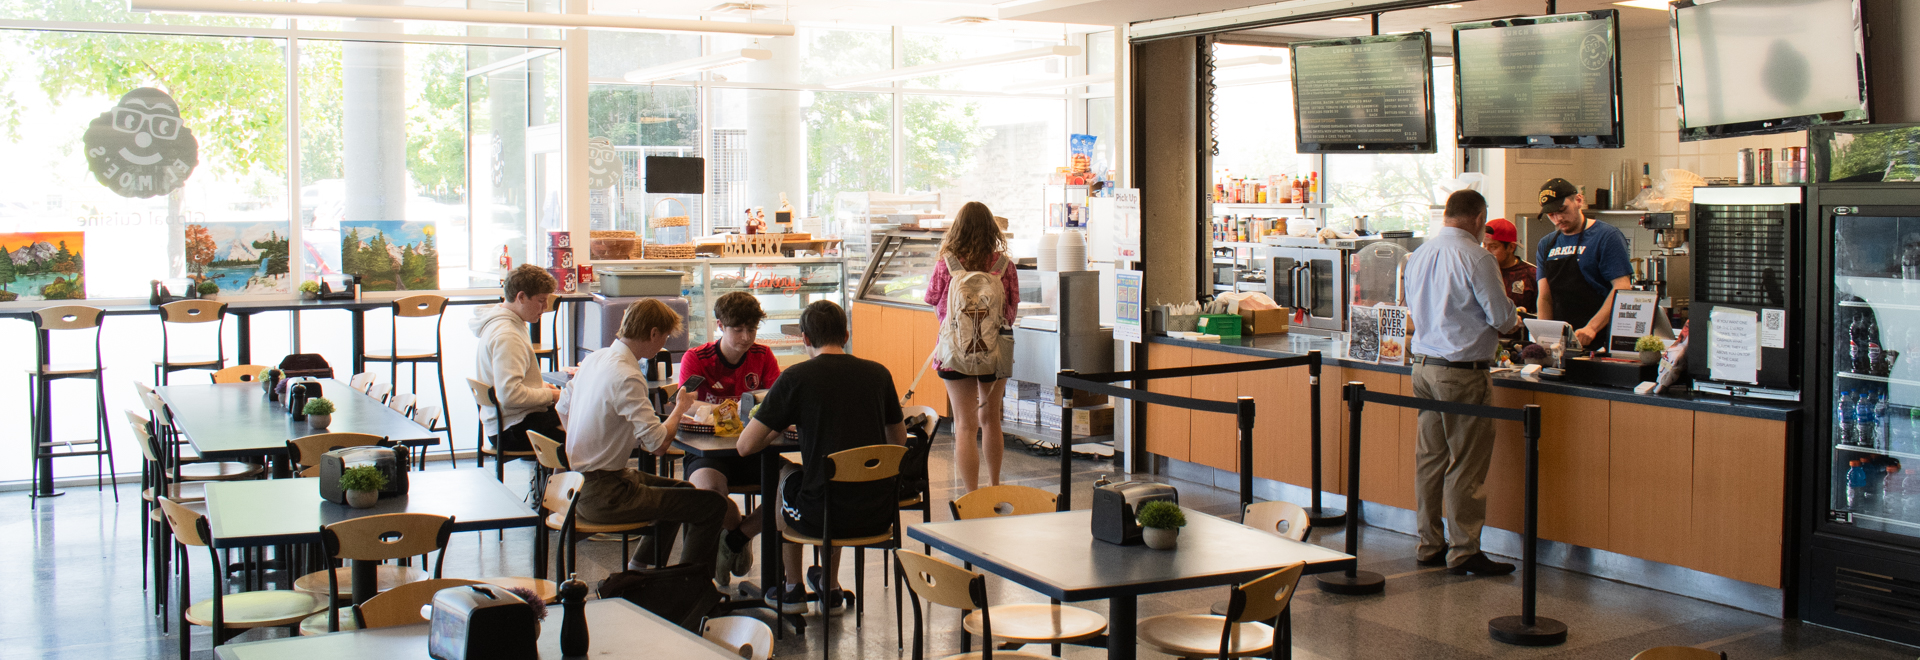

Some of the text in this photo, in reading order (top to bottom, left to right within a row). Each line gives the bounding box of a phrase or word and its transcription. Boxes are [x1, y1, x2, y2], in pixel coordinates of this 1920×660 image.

[1115, 193, 1138, 204] Pick Up
[725, 234, 784, 255] BAKERY
[749, 271, 802, 298] Bakery
[1619, 302, 1627, 310] Tell
[1631, 303, 1642, 311] what
[1379, 308, 1405, 319] TATERS
[1381, 317, 1402, 328] OVER
